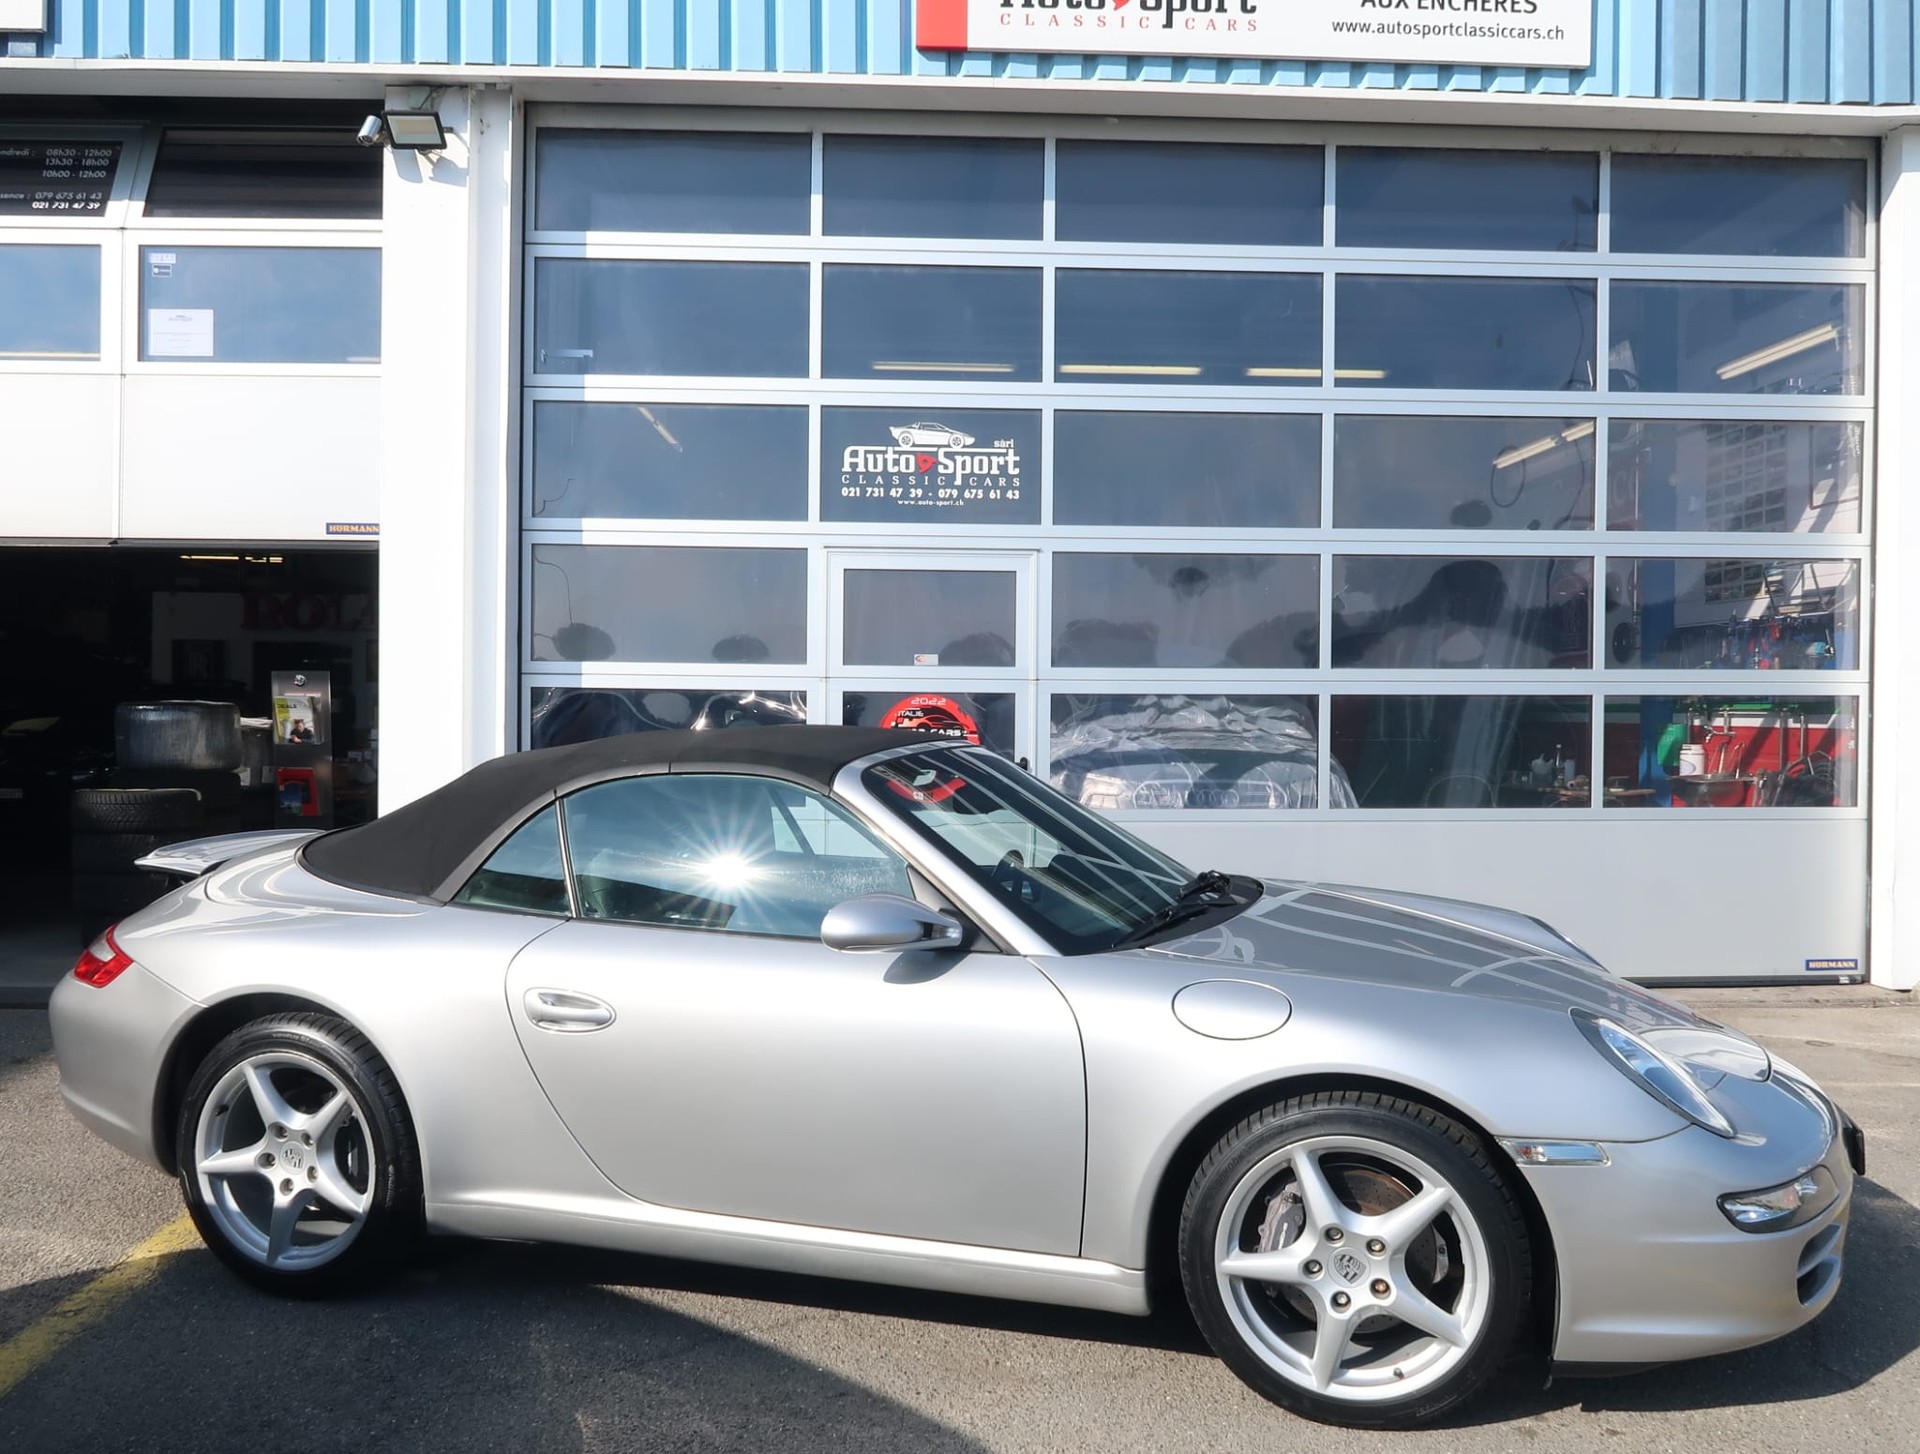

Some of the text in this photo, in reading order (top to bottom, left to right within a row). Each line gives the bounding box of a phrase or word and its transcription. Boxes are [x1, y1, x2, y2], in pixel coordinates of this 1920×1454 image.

[1000, 13, 1150, 29] CLASSIC
[1184, 18, 1258, 32] CARS
[1332, 20, 1564, 40] www.autosportclassiccars.ch
[46, 149, 76, 157] 08h30
[84, 149, 112, 157] 12h00
[45, 158, 74, 166] 13h30
[82, 158, 109, 166] 18h00
[42, 170, 71, 178] 10h00
[79, 170, 106, 178] 12h00
[35, 191, 54, 199] 079
[55, 191, 74, 199] 675
[76, 191, 87, 199] 61
[90, 192, 102, 200] 43
[32, 201, 100, 209] 021 731 47 39
[841, 446, 1020, 486] Auto Sport
[841, 474, 1020, 487] CLASSIC CARS
[841, 487, 860, 497] 021
[865, 487, 884, 498] 731
[889, 488, 903, 498] 47
[909, 488, 923, 498] 39
[938, 488, 958, 498] 079
[963, 489, 984, 499] 675
[989, 489, 1001, 499] 61
[1006, 489, 1020, 499] 43
[897, 499, 965, 507] www.auto-sport.ch
[911, 697, 946, 706] 2022
